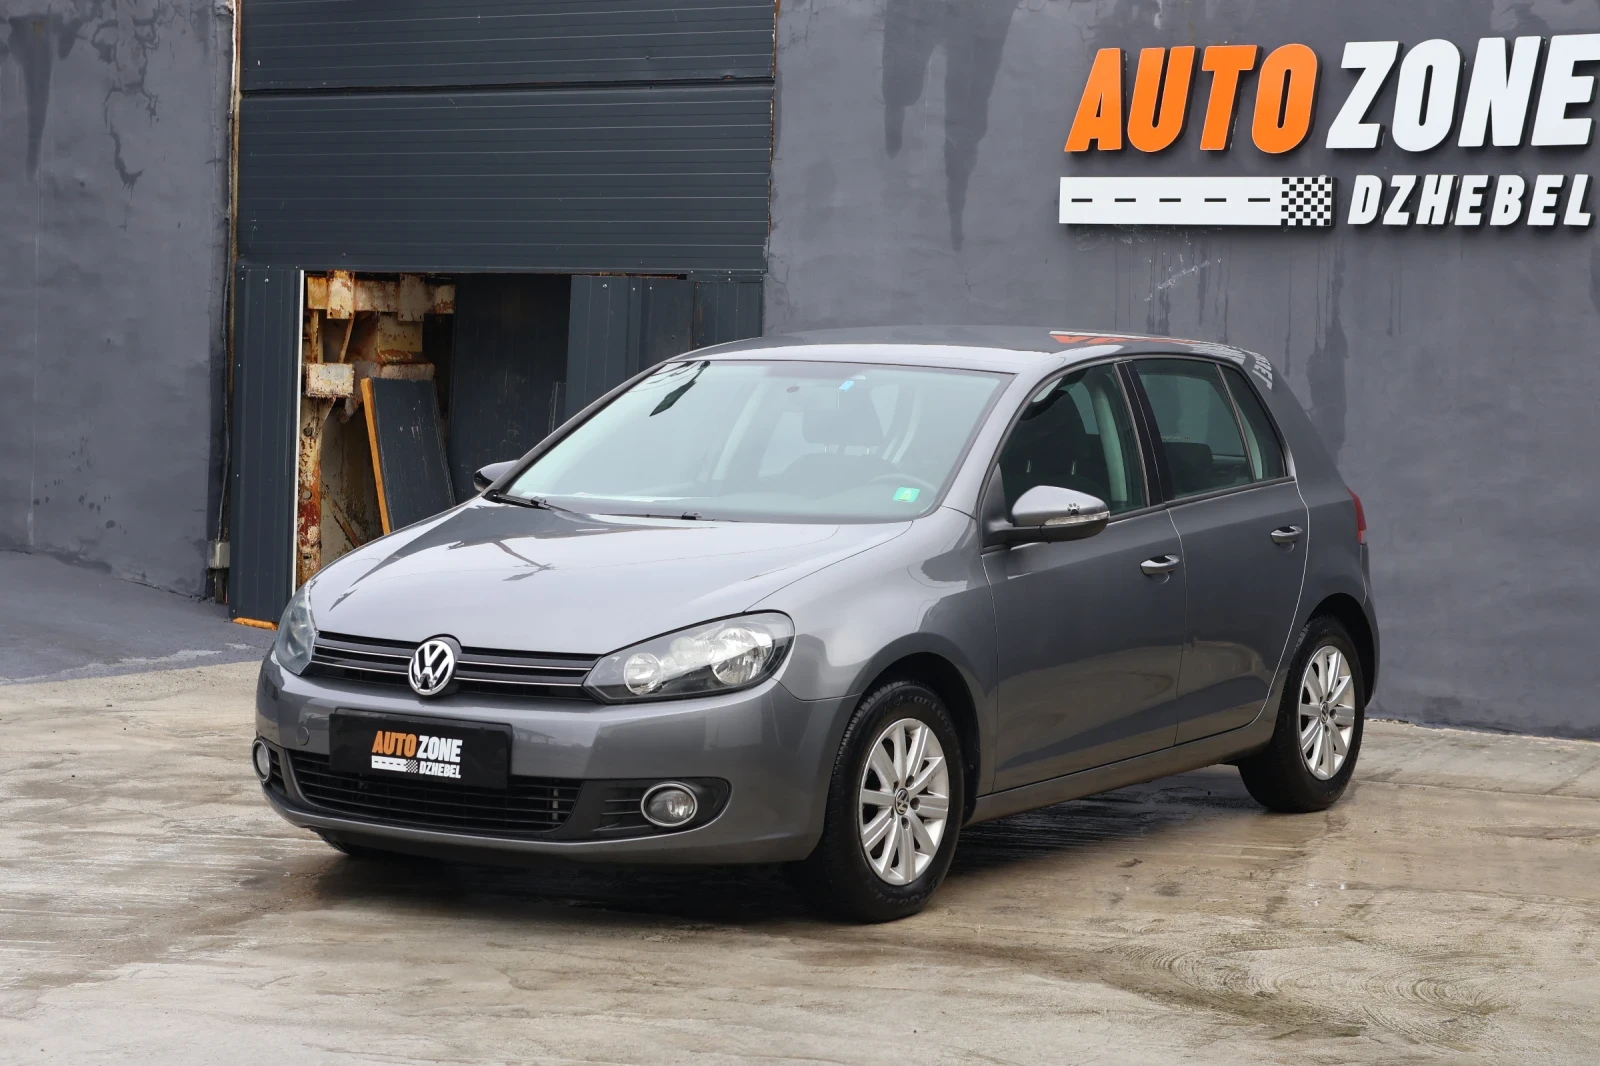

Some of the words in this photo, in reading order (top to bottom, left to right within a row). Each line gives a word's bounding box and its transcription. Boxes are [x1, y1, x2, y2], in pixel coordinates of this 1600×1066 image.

[1065, 44, 1318, 153] AUTO
[1326, 34, 1600, 152] ZONE
[1347, 174, 1592, 226] DZHEBEL
[372, 731, 417, 757] AUTO
[417, 735, 463, 762] ZONE
[419, 761, 461, 778] DZHEBEL
